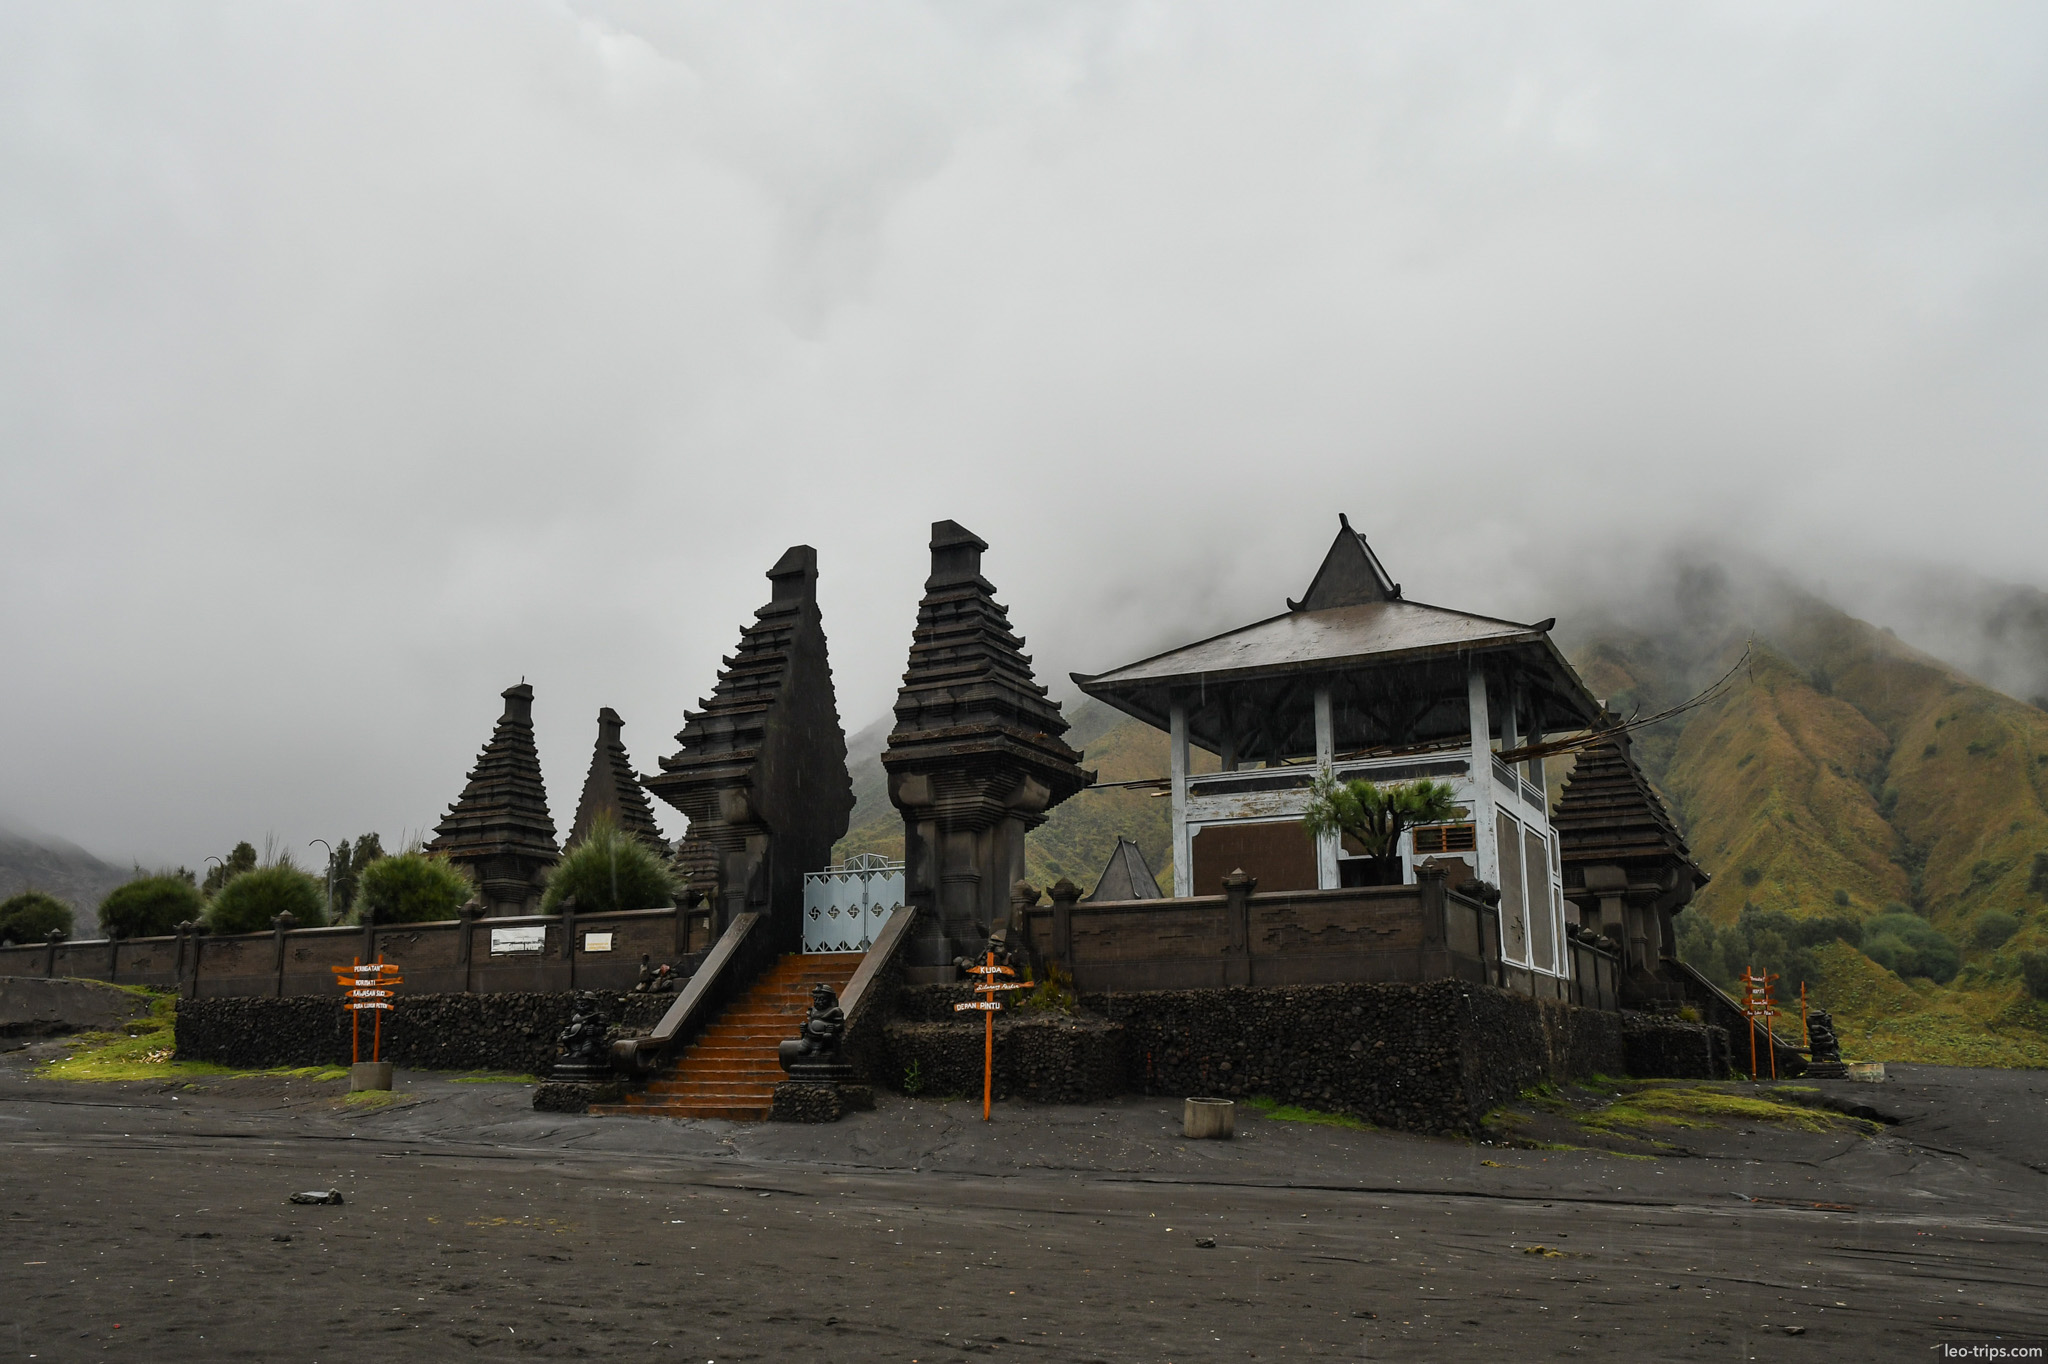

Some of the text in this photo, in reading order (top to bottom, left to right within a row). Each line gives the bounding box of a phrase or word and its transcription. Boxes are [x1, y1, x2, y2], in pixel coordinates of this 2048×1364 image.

[980, 966, 1002, 974] KUDA
[957, 1001, 1000, 1011] DEPAN PINTU
